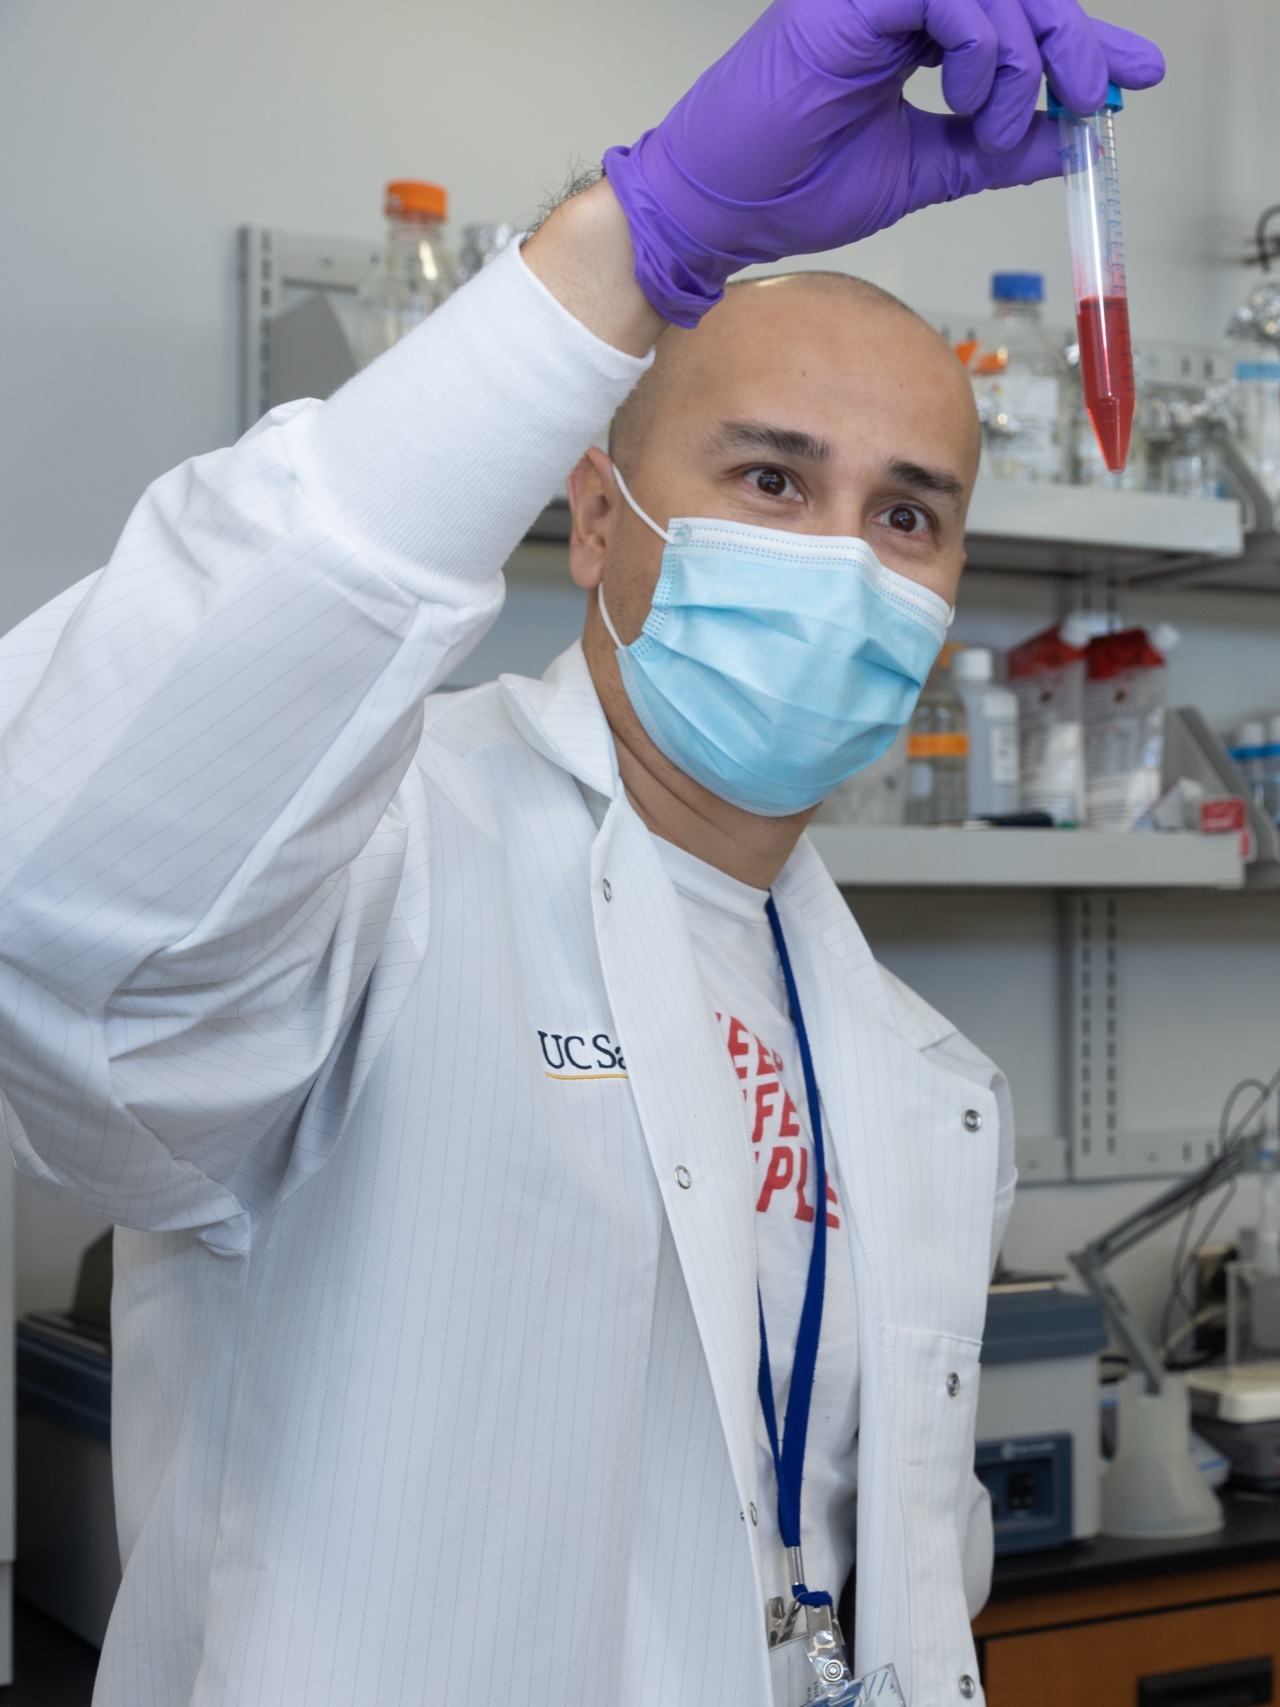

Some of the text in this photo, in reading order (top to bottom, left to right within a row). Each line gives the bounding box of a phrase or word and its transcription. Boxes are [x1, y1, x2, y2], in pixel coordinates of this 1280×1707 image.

[537, 1030, 592, 1070] UC
[742, 1081, 800, 1143] FE
[754, 1146, 840, 1230] PLE
